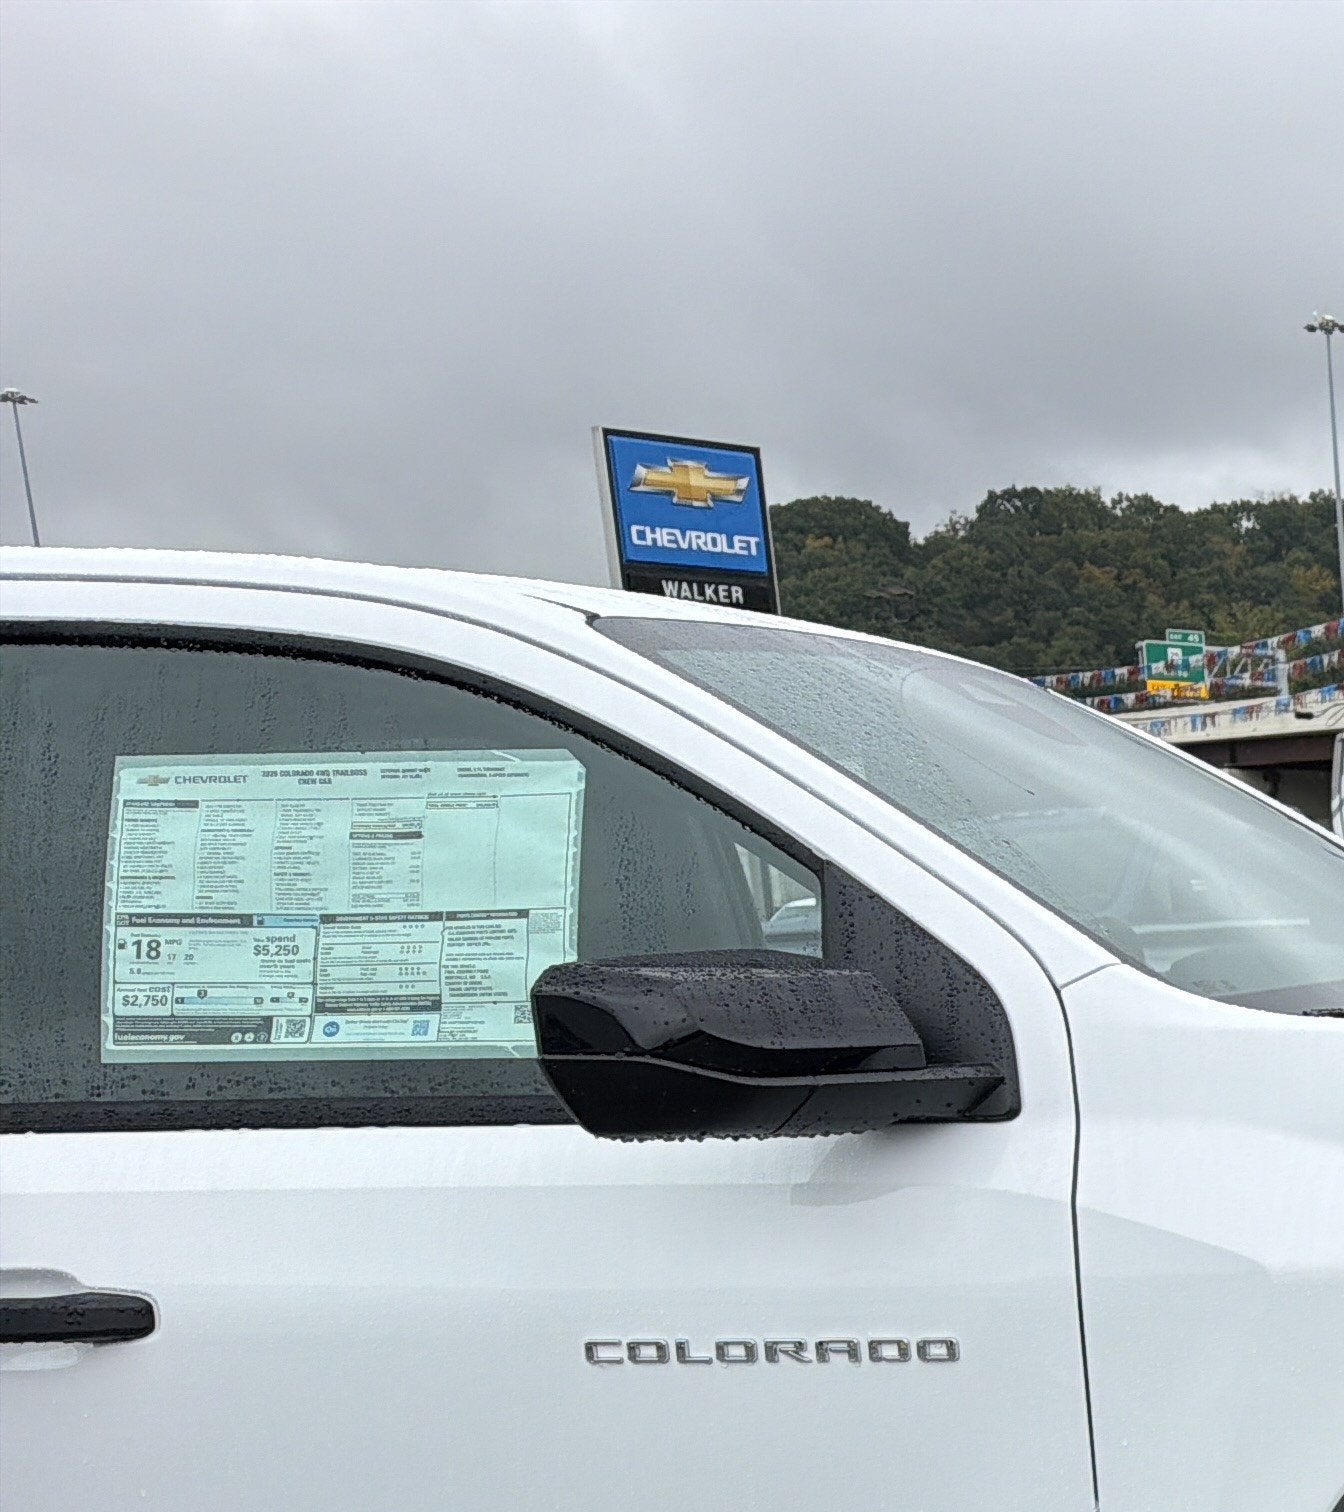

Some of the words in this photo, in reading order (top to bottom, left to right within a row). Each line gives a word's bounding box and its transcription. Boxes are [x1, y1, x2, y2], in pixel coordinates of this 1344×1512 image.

[630, 524, 760, 557] CHEVROLET
[661, 579, 744, 604] WALKER
[174, 775, 249, 784] CHEVROLET
[266, 933, 296, 944] spend
[132, 939, 161, 960] 18
[253, 944, 300, 958] $5,250
[122, 994, 168, 1008] $2,750
[114, 1032, 186, 1042] fueleconomy.gov
[584, 1336, 961, 1365] COLORADO
